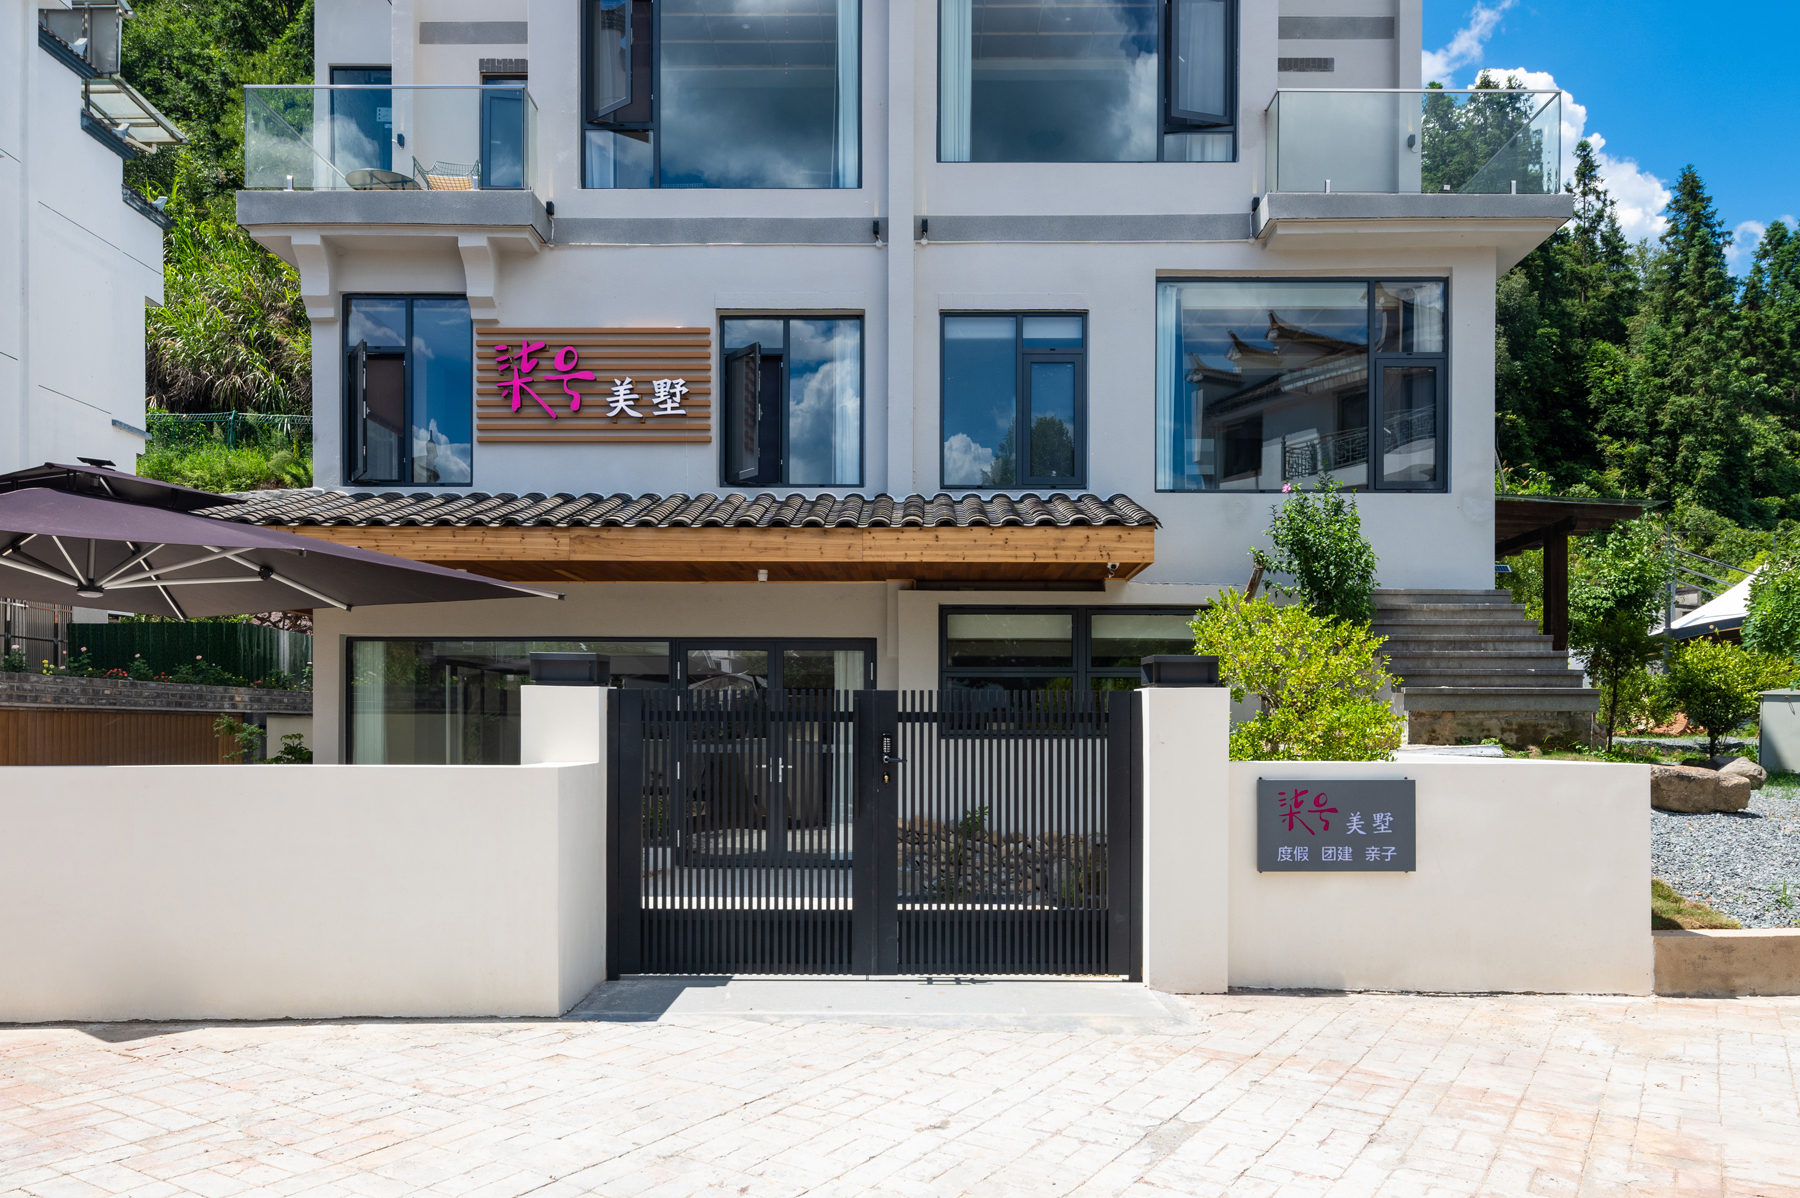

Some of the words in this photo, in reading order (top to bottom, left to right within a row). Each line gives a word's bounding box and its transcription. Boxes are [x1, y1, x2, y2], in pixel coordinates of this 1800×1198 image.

[605, 376, 690, 418] 美墅
[1345, 811, 1394, 835] 美墅
[1277, 845, 1309, 862] 度假
[1321, 845, 1353, 862] 团建
[1365, 845, 1397, 862] 亲子
